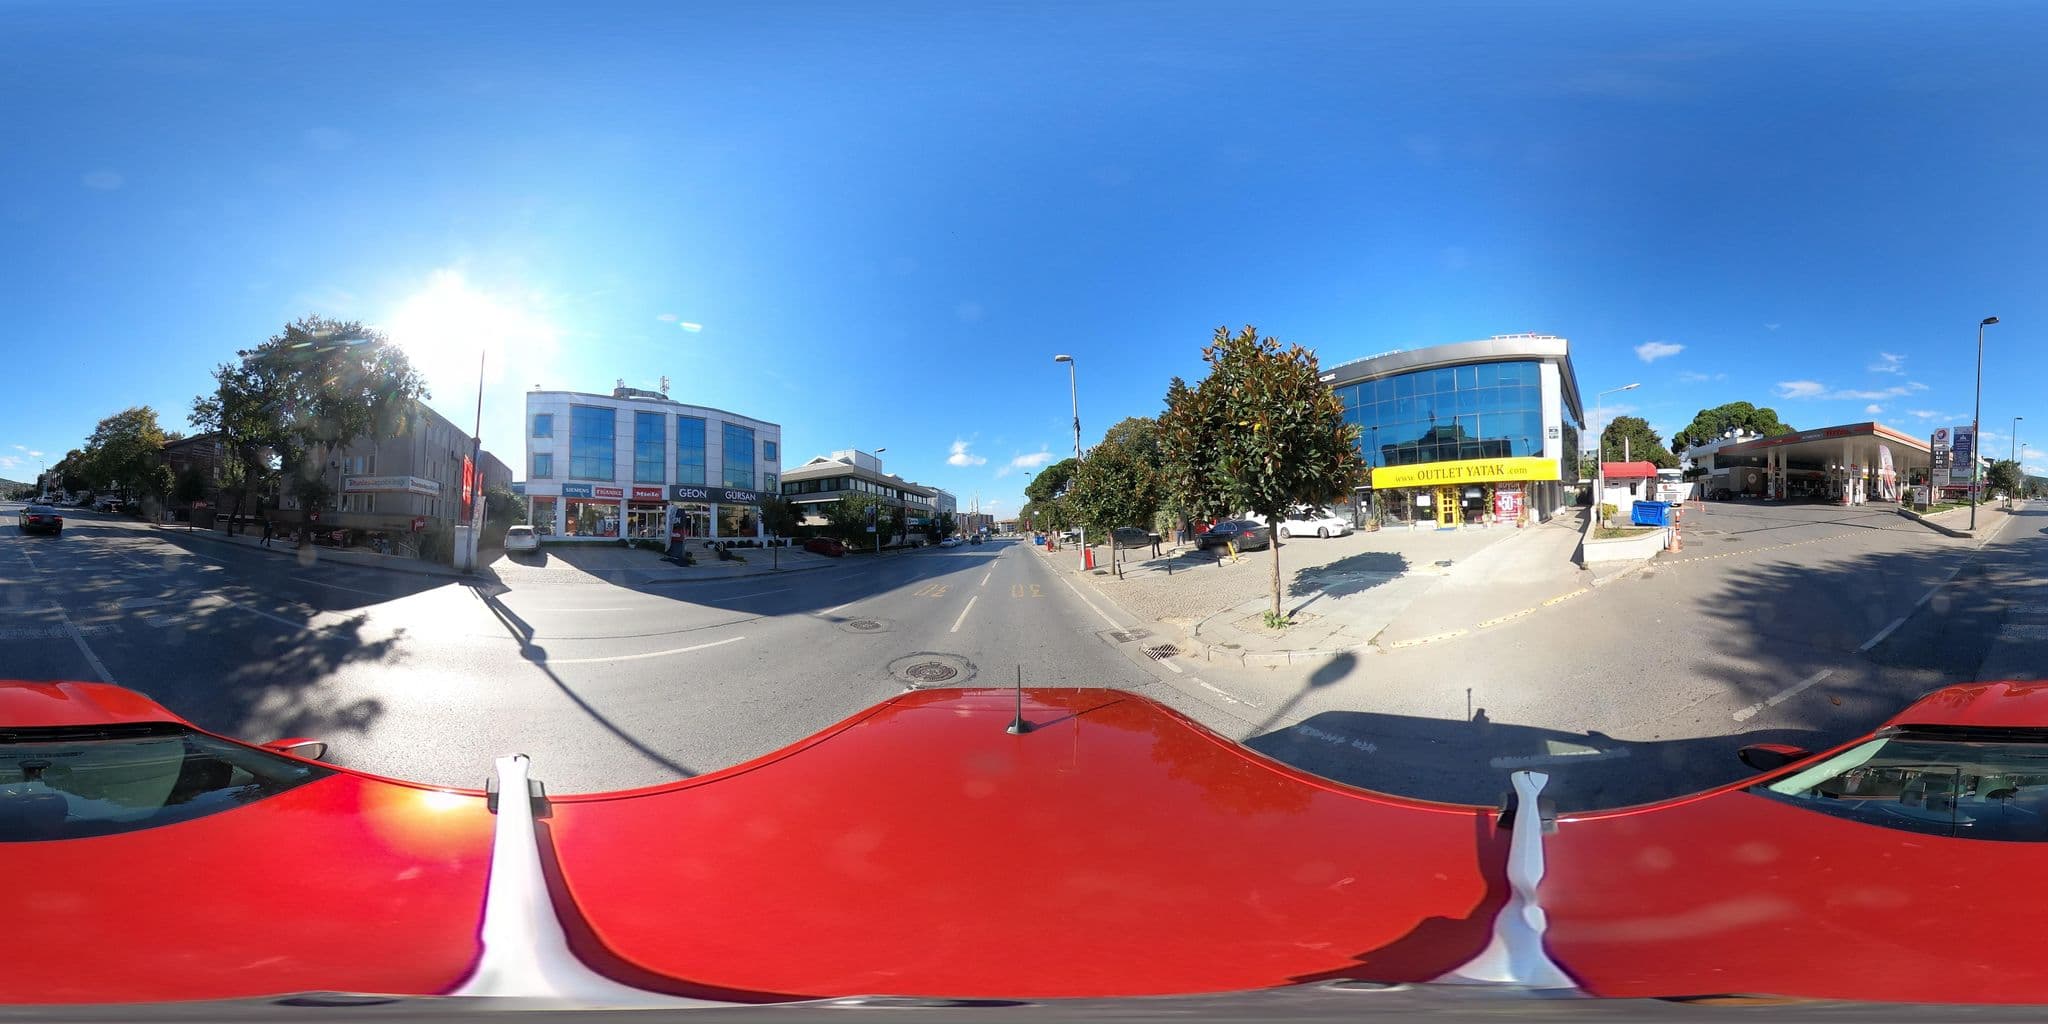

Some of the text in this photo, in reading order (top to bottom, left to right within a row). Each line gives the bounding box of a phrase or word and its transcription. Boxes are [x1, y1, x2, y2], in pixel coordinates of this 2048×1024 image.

[1417, 467, 1463, 481] OUTLET
[1466, 464, 1504, 477] YATAK
[679, 488, 707, 500] GEON
[725, 488, 757, 501] GÜRSAN
